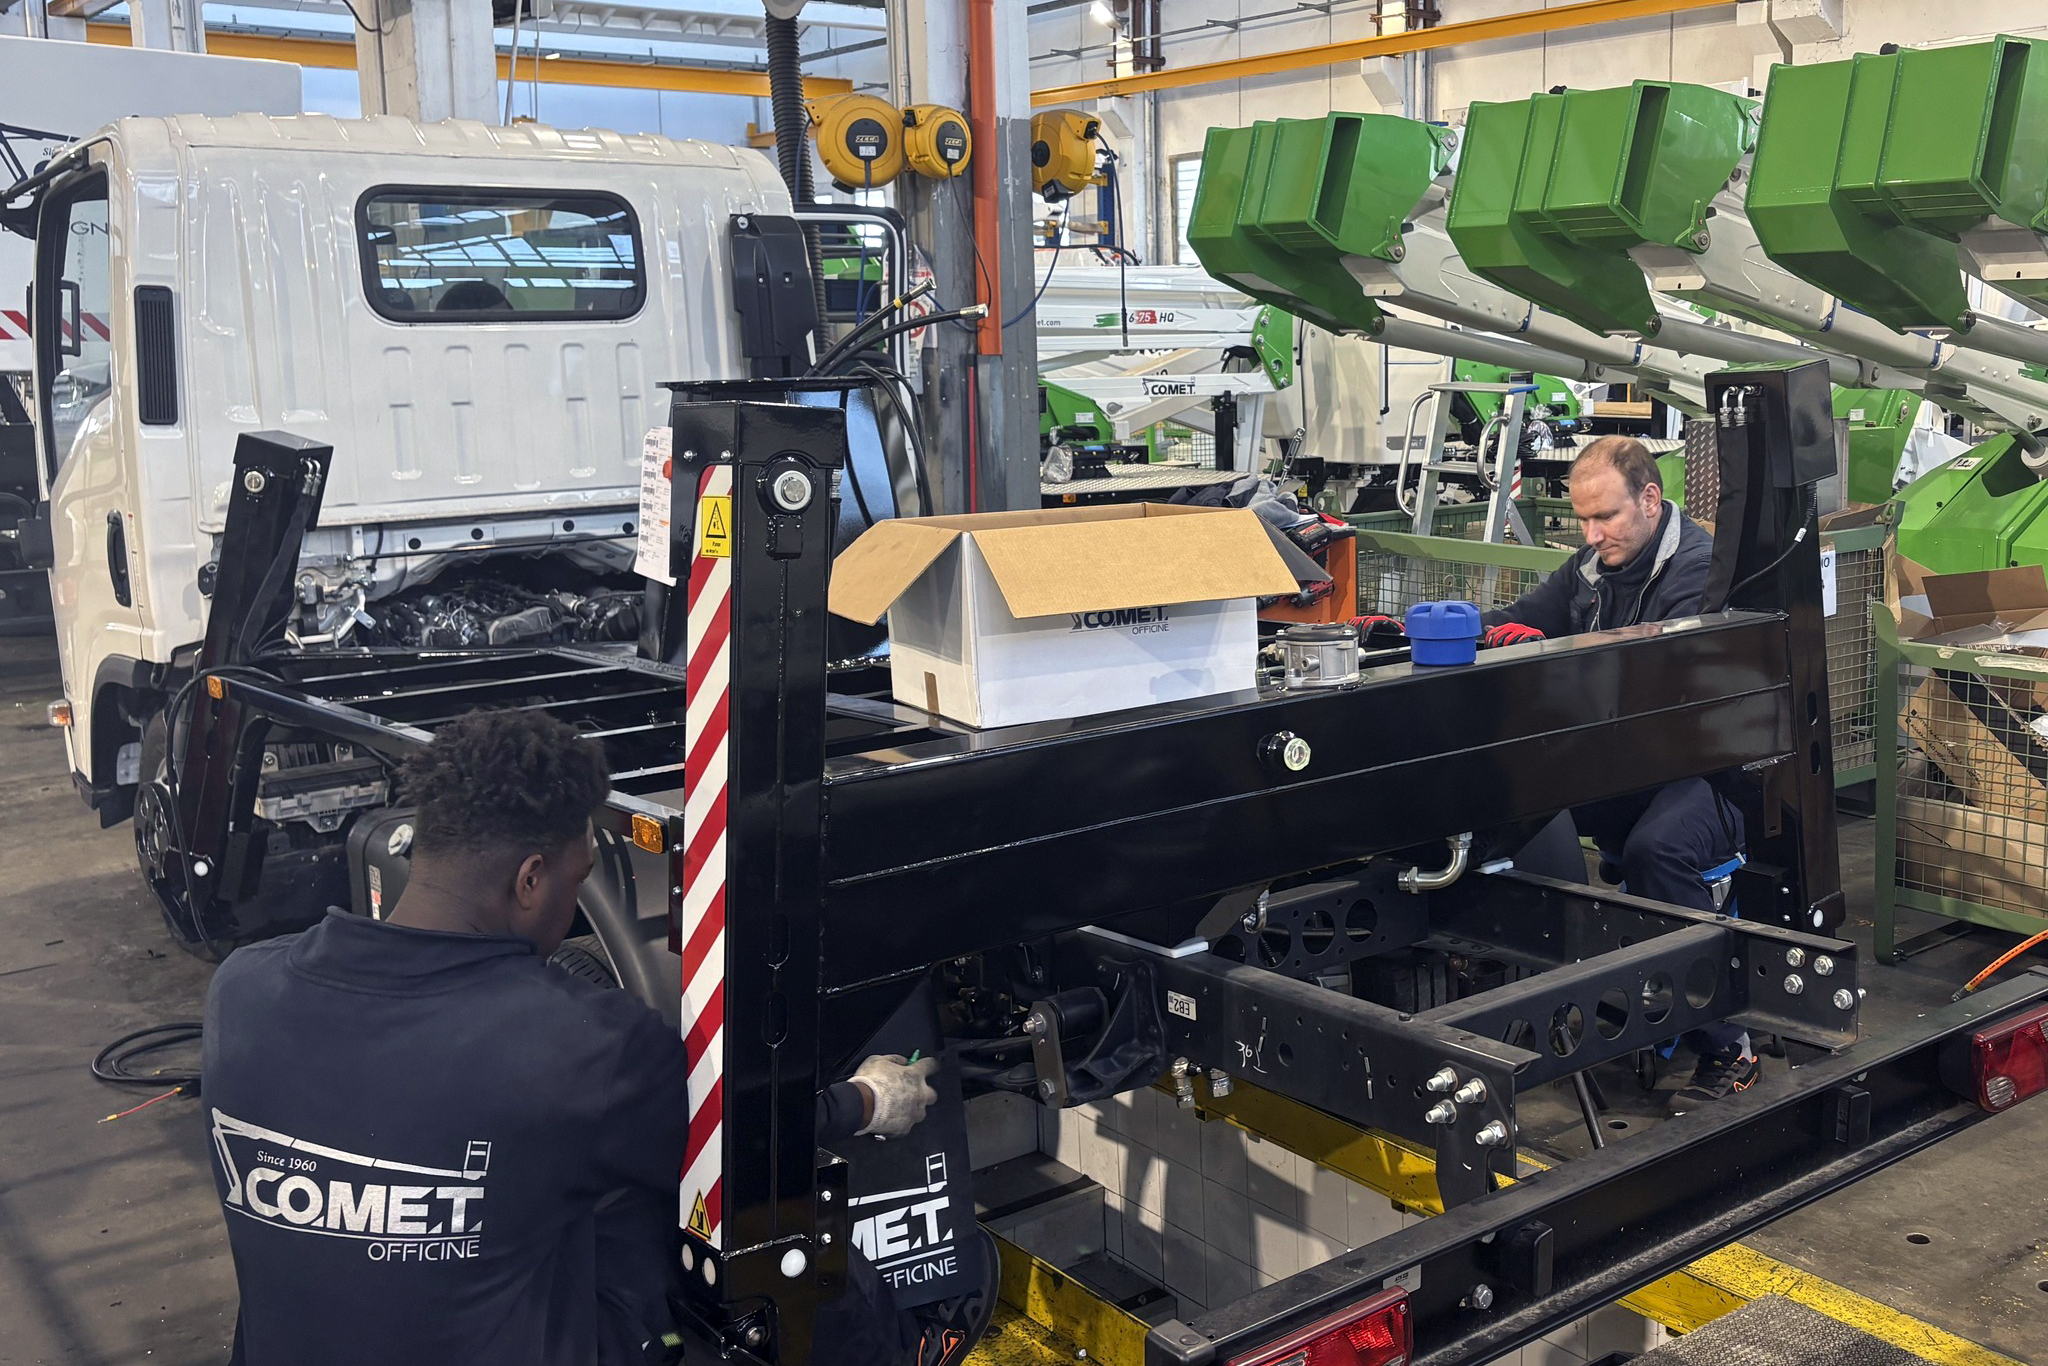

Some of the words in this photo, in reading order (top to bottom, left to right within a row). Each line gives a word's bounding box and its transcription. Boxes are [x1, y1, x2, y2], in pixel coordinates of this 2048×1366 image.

[1159, 312, 1175, 323] HQ
[1132, 623, 1169, 635] OFFICINE
[256, 1150, 285, 1166] Since
[288, 1157, 317, 1172] 1960
[367, 1239, 480, 1261] OFFICINE
